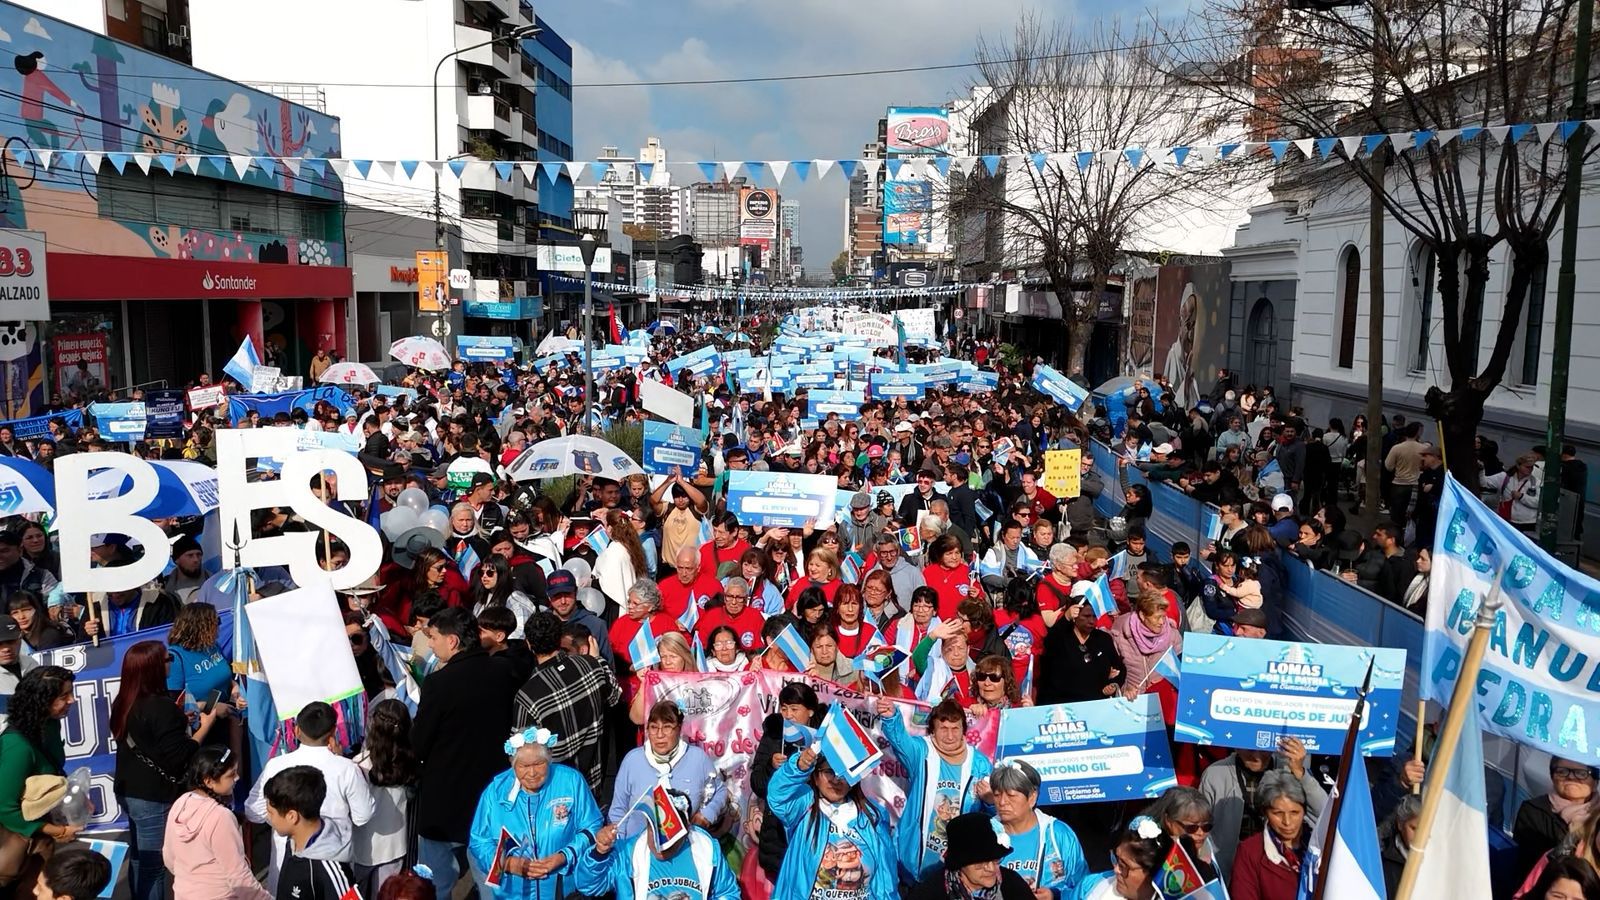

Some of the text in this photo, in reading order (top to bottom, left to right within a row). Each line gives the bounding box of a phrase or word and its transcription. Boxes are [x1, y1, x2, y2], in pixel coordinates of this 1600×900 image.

[895, 122, 942, 140] Bross
[555, 253, 582, 262] Cielo
[214, 274, 257, 290] Santander
[453, 274, 467, 284] NX
[529, 461, 538, 471] EL
[1269, 662, 1322, 677] LOMAS
[1259, 673, 1329, 687] POR LA PATRIA
[1224, 695, 1252, 704] CENTRO
[1266, 699, 1303, 708] JUBILADOS
[1215, 704, 1241, 716] LOS
[1243, 706, 1306, 722] ABUELOS
[1308, 712, 1326, 722] DE
[1040, 722, 1086, 735] LOMAS
[1034, 730, 1096, 743] POR LA PATRIA
[1047, 756, 1080, 765] JUBILADOS
[1086, 751, 1130, 762] PENSIONADOS
[1037, 761, 1111, 776] ANTONIO GIL
[1071, 792, 1106, 800] Comunidad
[1007, 861, 1020, 871] DE
[661, 878, 672, 887] DE
